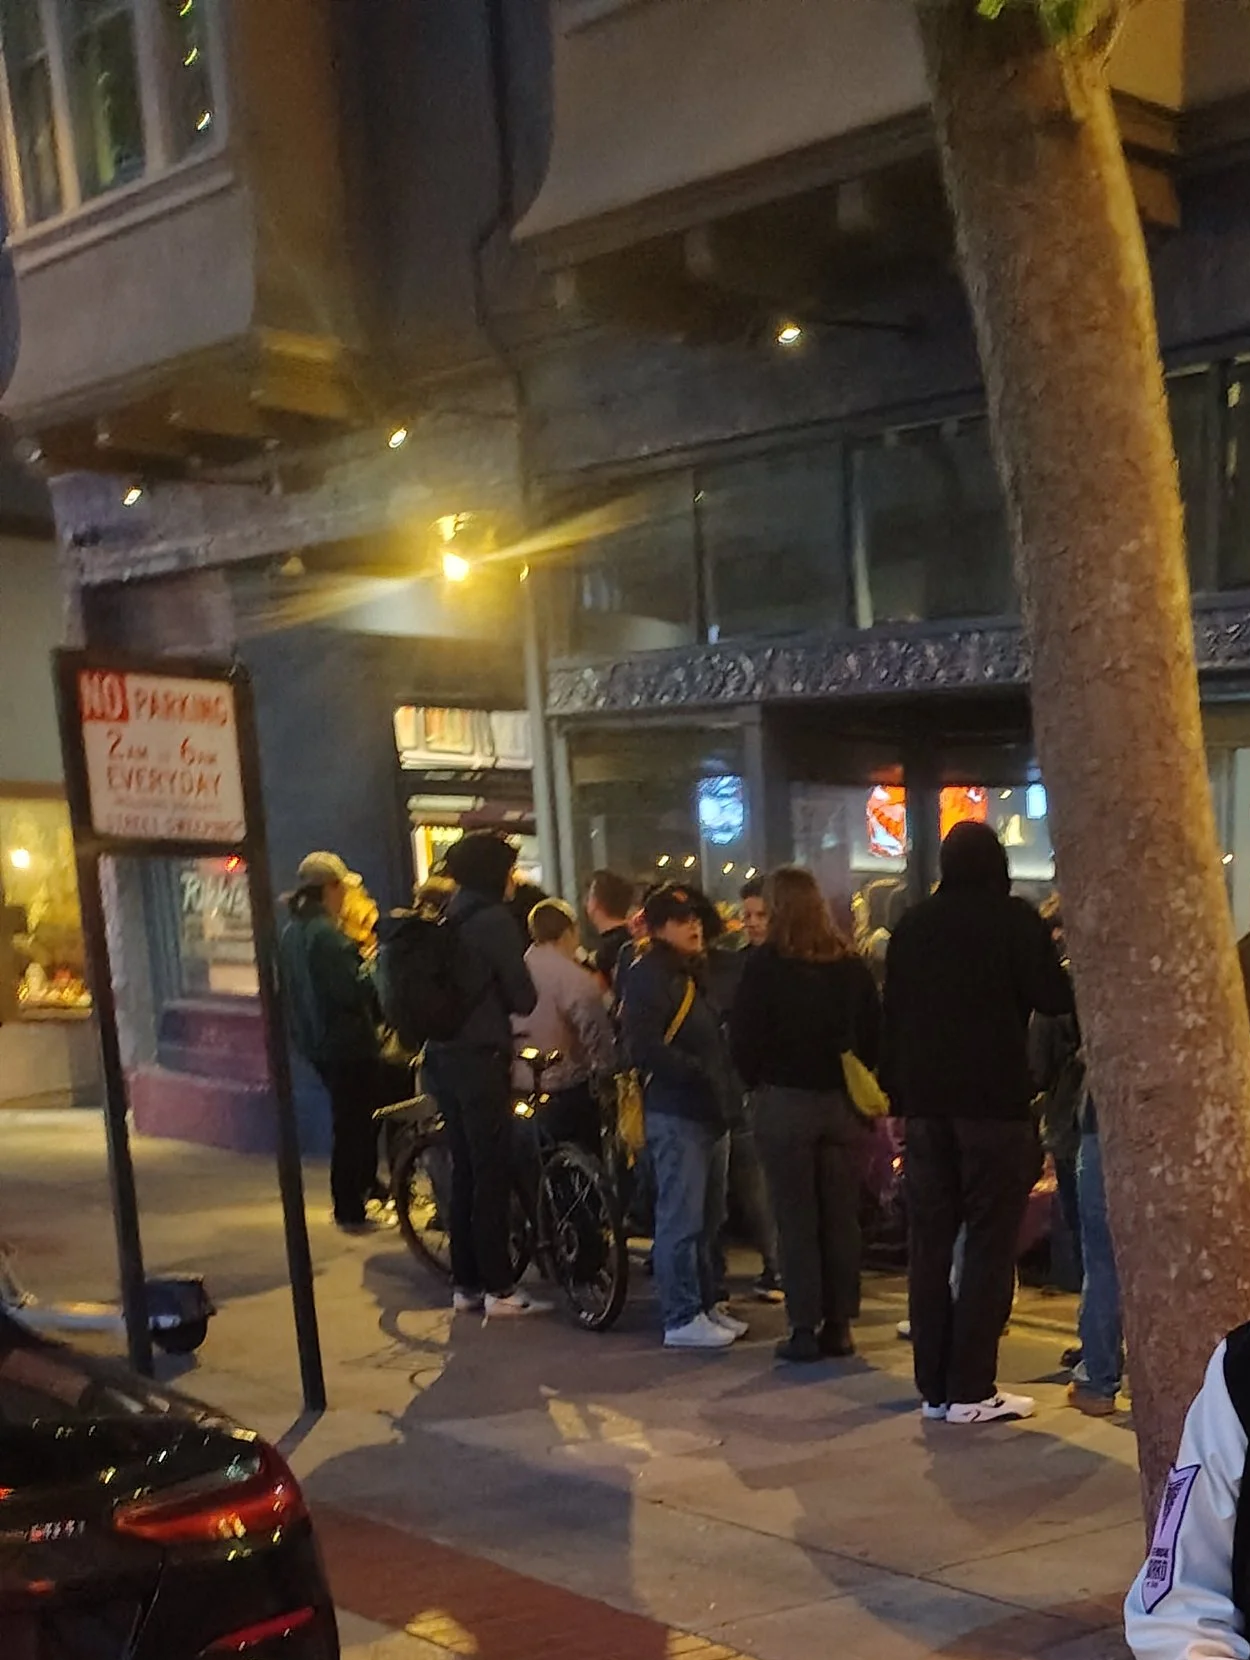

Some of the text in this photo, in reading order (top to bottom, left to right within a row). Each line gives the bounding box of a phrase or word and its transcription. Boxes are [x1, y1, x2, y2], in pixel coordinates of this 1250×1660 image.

[80, 671, 228, 727] NO PARKING
[106, 765, 223, 797] EVERYDAY
